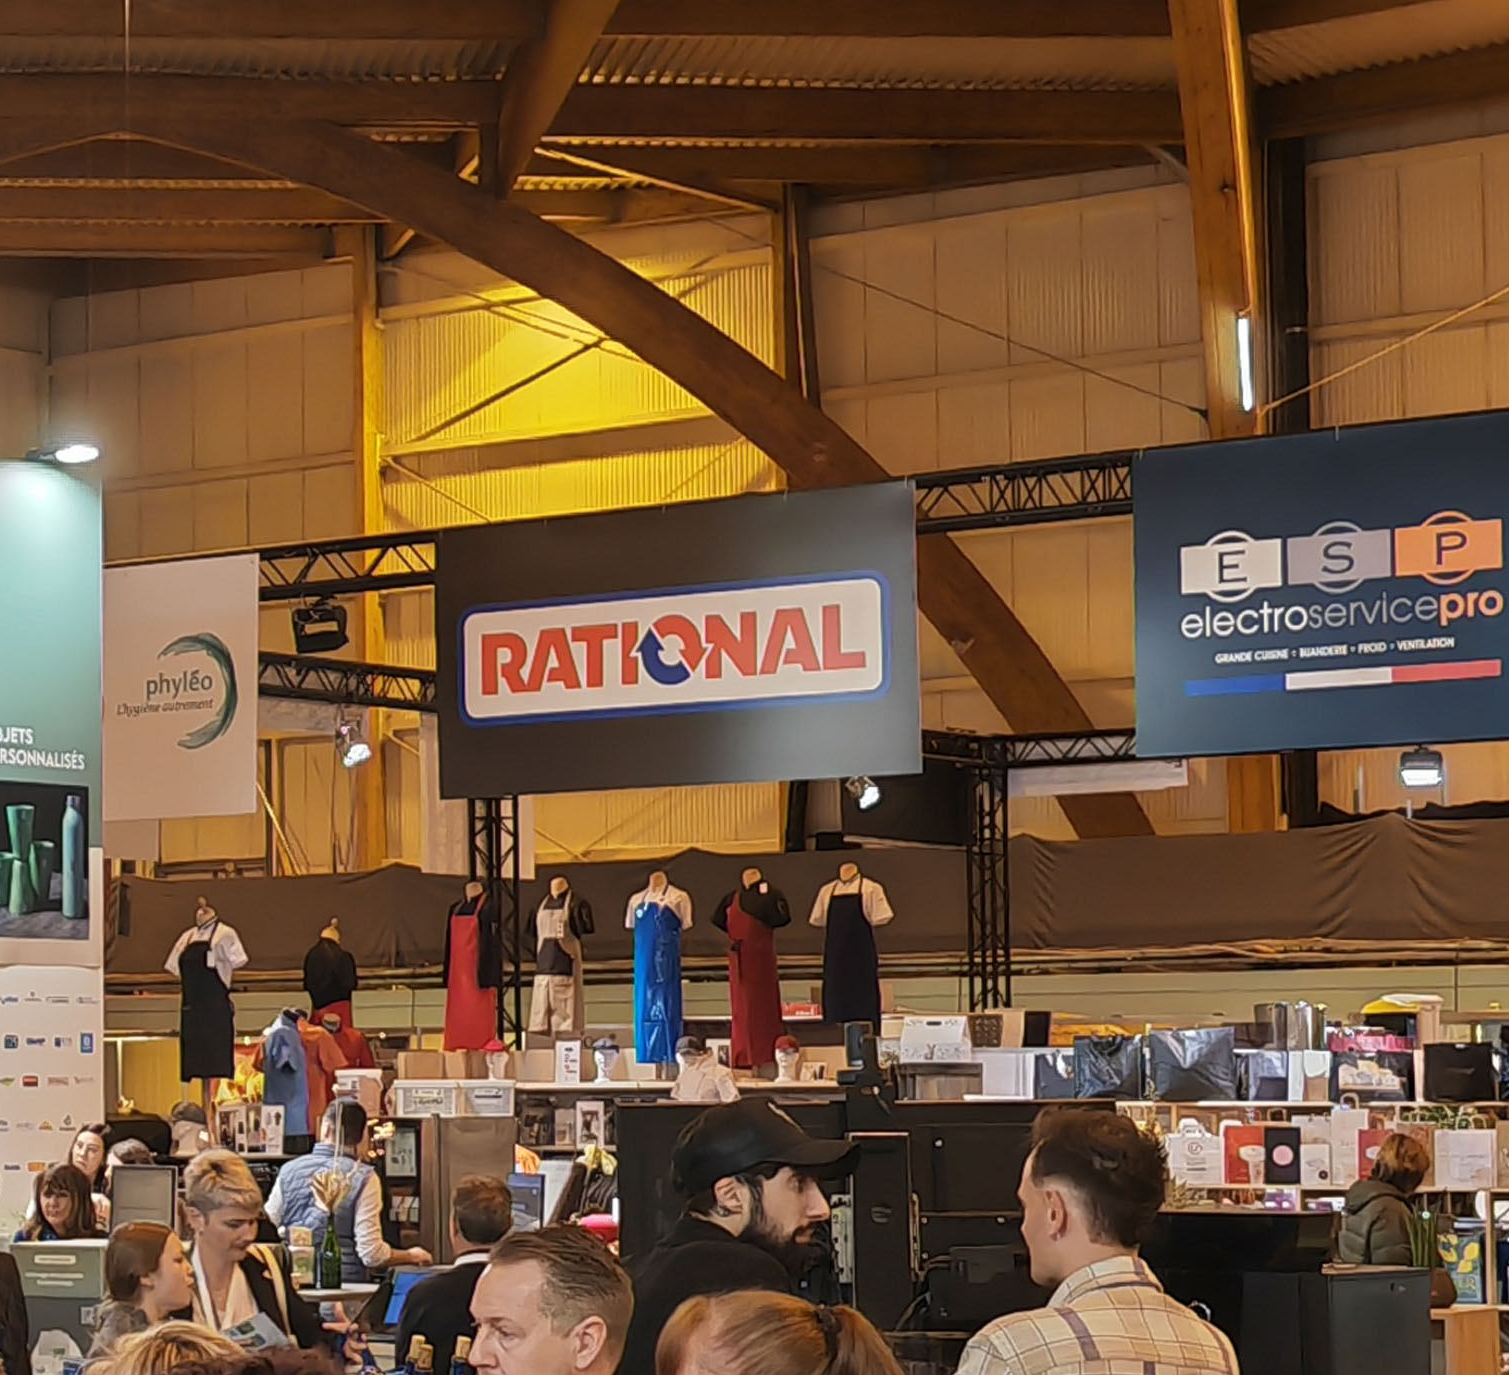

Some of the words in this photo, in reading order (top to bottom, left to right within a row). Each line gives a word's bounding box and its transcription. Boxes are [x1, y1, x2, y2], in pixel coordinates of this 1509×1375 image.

[1181, 589, 1504, 639] electroservicepro
[481, 604, 867, 695] RATIONAL
[1215, 652, 1252, 664] GRANDE
[1254, 649, 1289, 662] CUISINE
[1358, 643, 1387, 654] FROID
[1397, 637, 1455, 652] VENTILATION
[146, 669, 213, 700] phyléo
[162, 699, 214, 712] autrement
